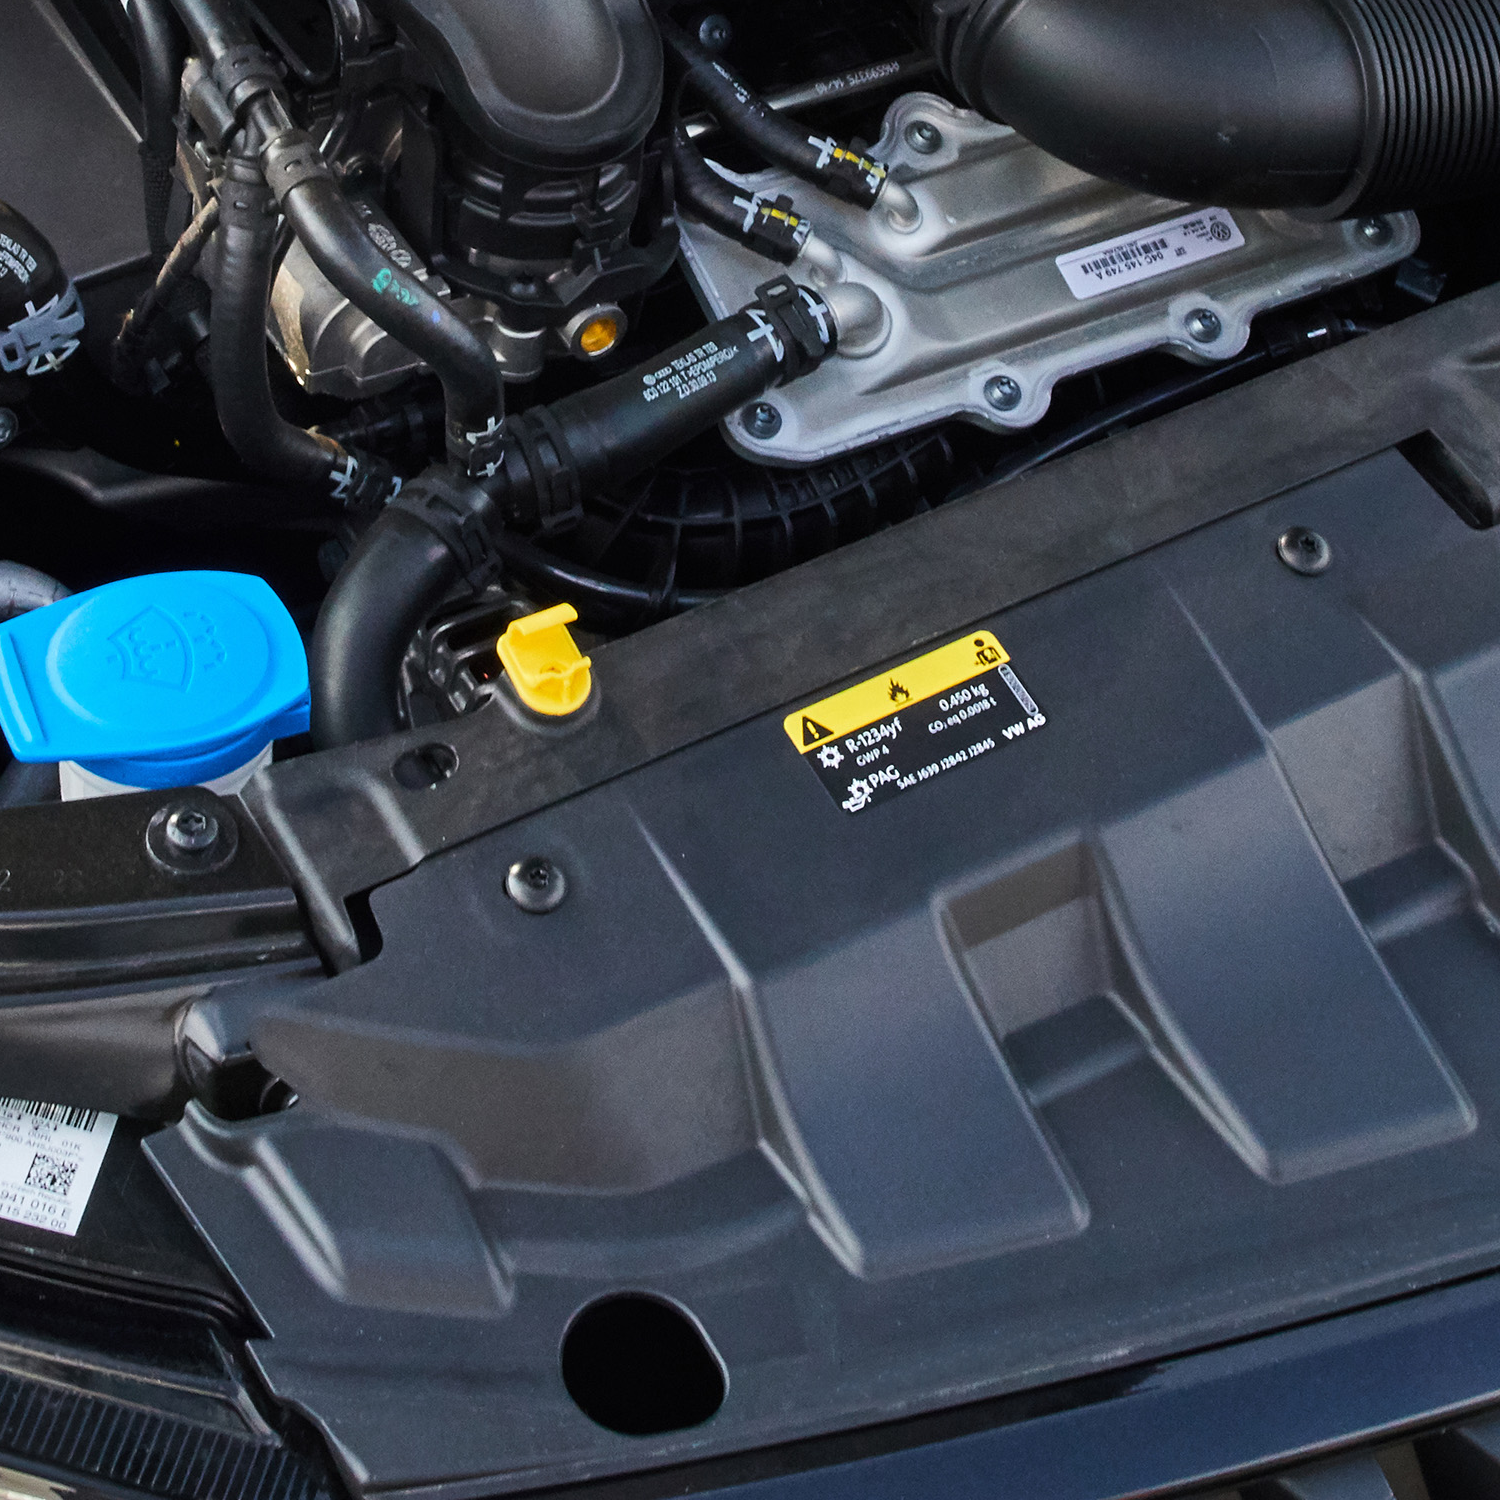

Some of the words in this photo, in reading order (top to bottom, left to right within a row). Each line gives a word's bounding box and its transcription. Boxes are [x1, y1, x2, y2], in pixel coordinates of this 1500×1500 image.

[1123, 257, 1142, 272] 145
[1143, 250, 1164, 265] 04C
[1094, 270, 1104, 281] A
[1103, 264, 1123, 278] 749
[939, 689, 972, 712] 0.450
[970, 683, 990, 699] kg
[947, 715, 961, 727] eq
[958, 700, 990, 721] 0.0018
[845, 716, 903, 754] R-1234yf
[1002, 721, 1025, 741] VW
[1026, 712, 1047, 730] AG
[856, 747, 881, 767] GWP
[882, 744, 890, 755] 4
[868, 764, 900, 789] PAG
[897, 773, 917, 790] SAE
[29, 1198, 58, 1215] 016
[22, 1208, 50, 1224] 232
[49, 1215, 68, 1229] 00
